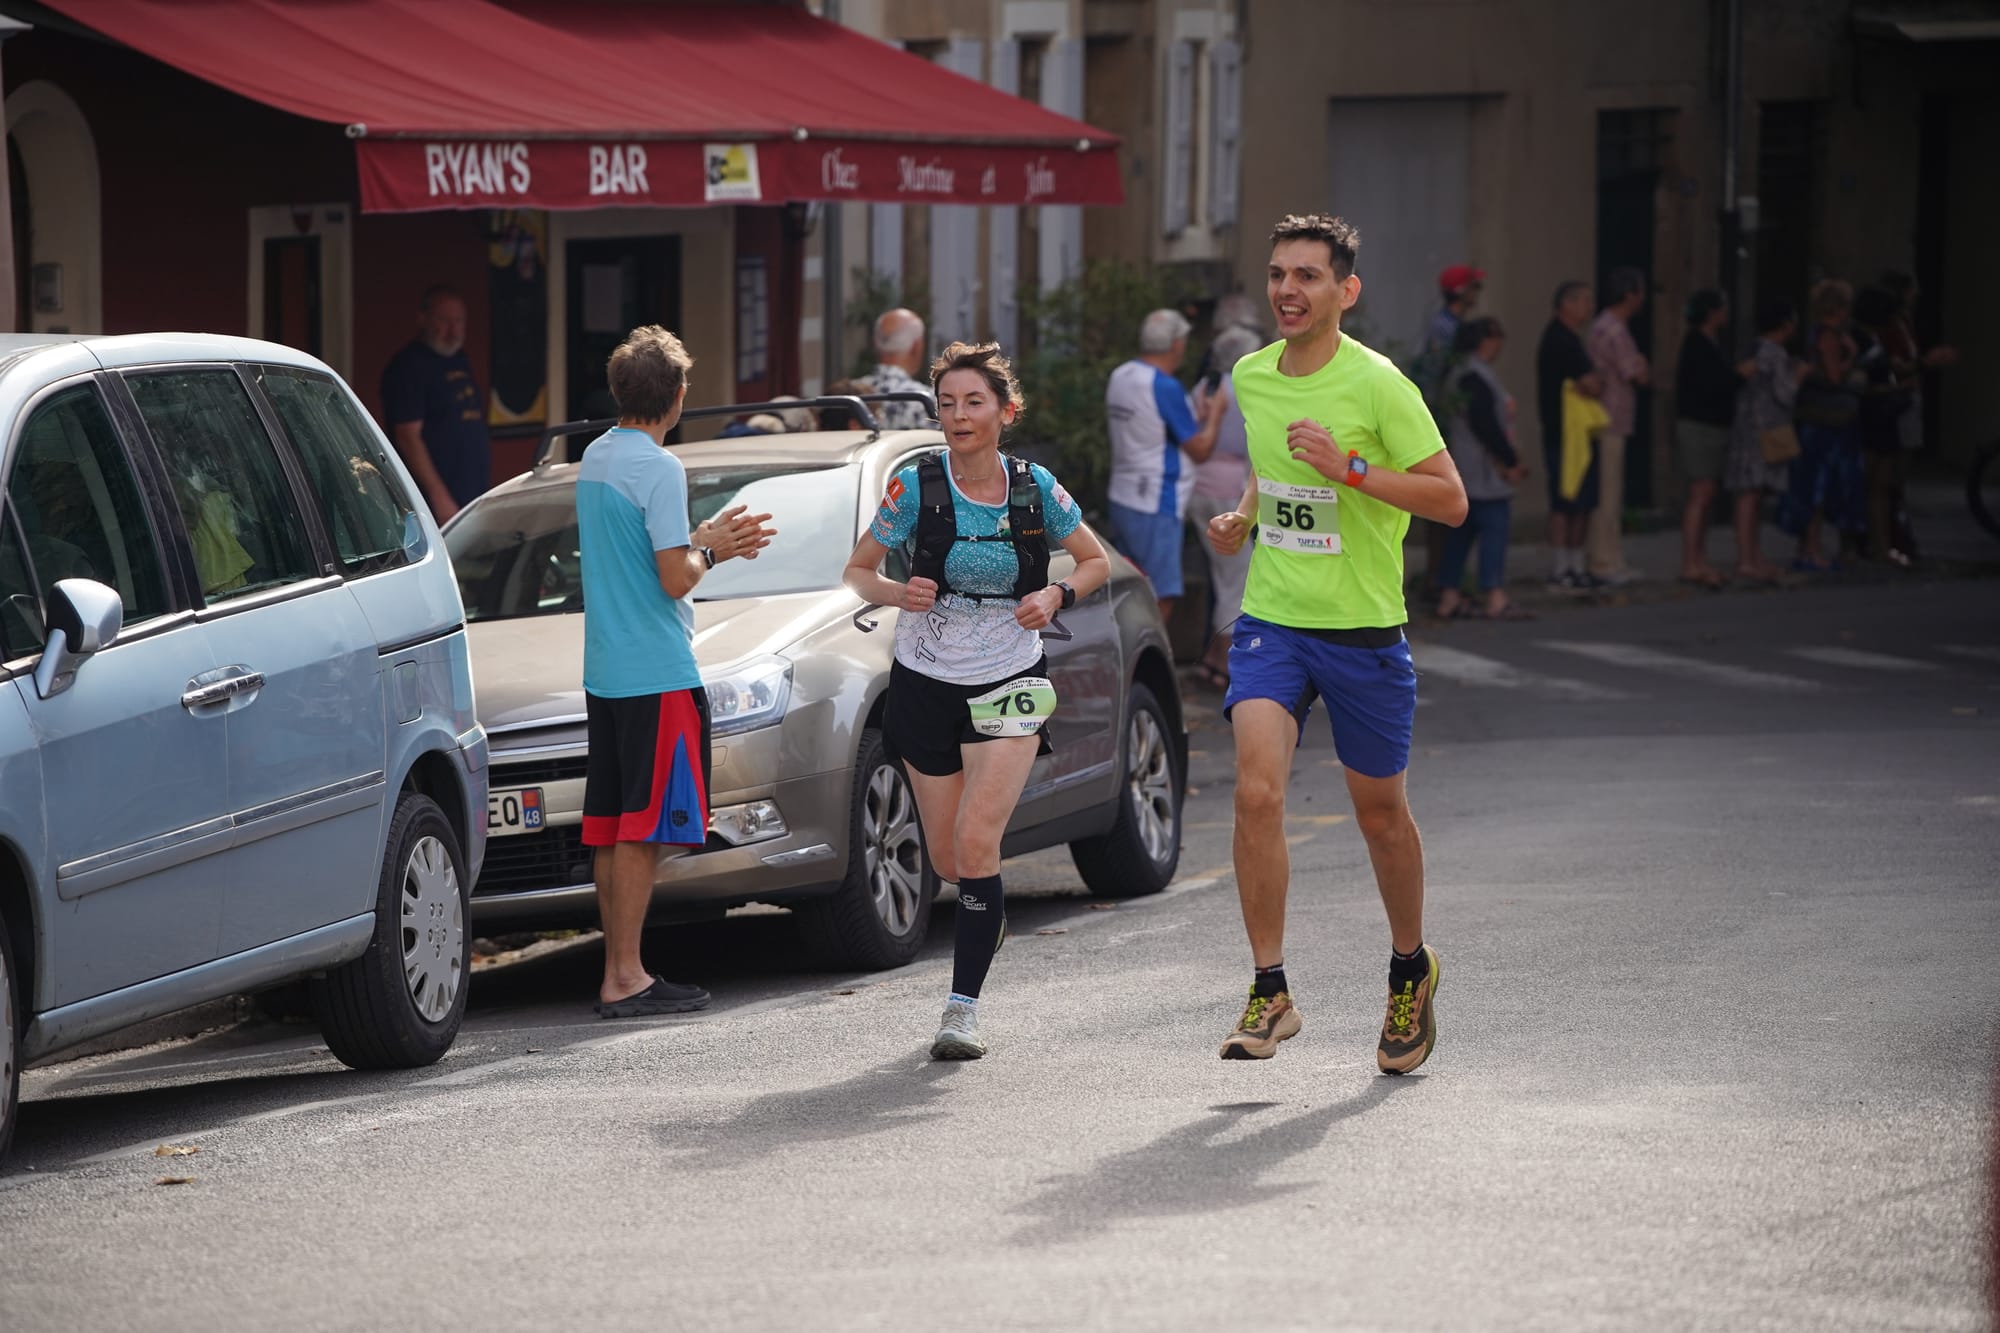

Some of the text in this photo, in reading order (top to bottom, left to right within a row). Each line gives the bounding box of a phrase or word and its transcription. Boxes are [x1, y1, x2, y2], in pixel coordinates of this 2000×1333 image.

[425, 143, 650, 196] RYAN'S BAR
[821, 147, 859, 191] Chez
[897, 155, 954, 193] Martine
[980, 164, 996, 195] et
[1276, 500, 1315, 531] 56
[992, 691, 1036, 716] 76
[525, 810, 540, 825] 48
